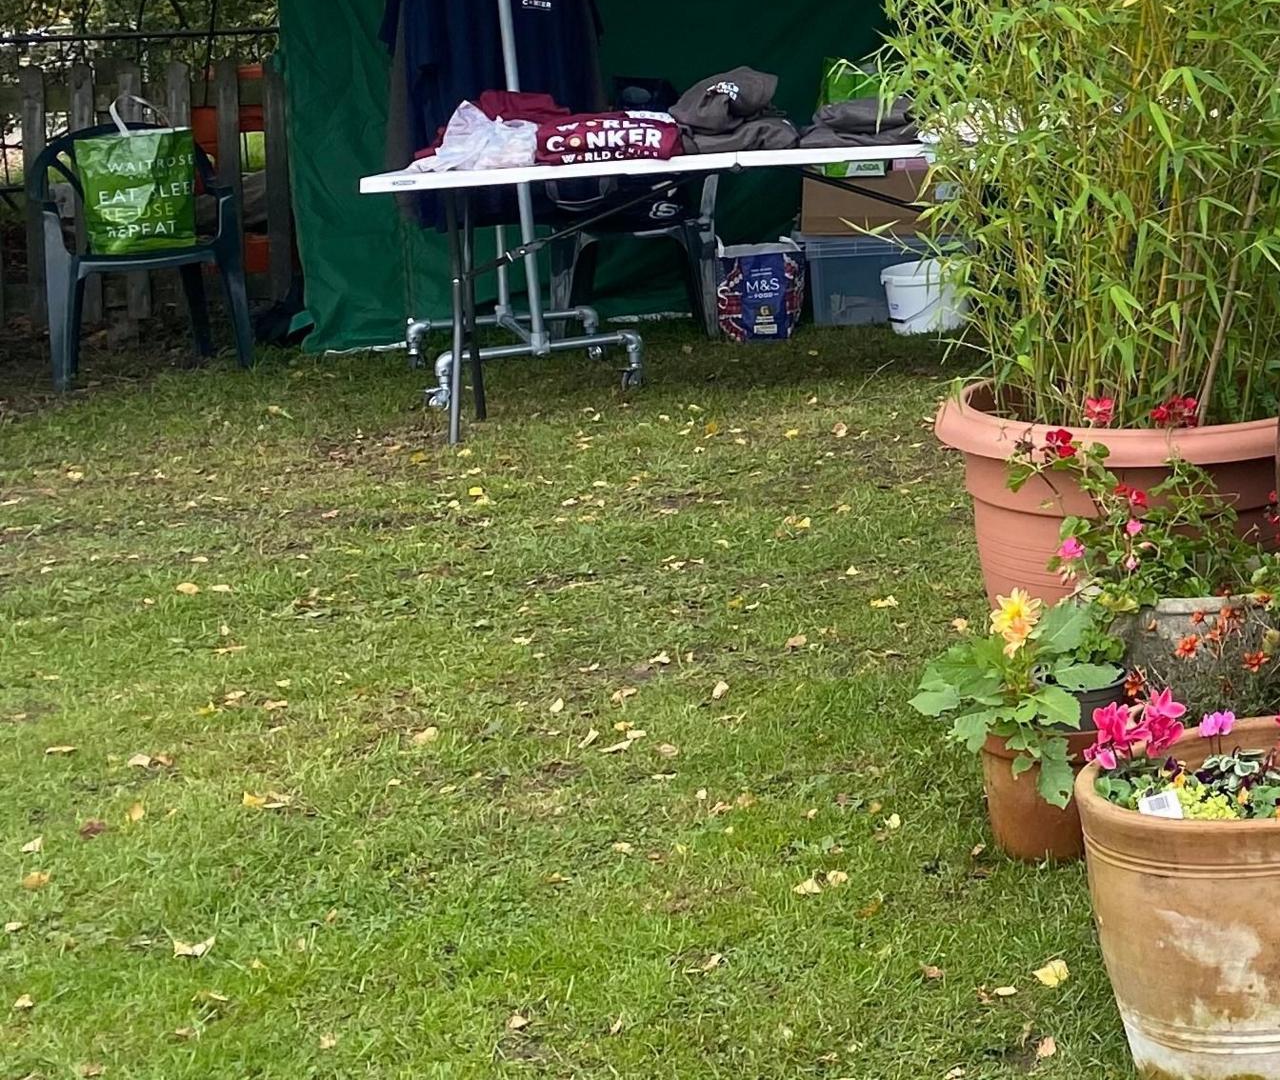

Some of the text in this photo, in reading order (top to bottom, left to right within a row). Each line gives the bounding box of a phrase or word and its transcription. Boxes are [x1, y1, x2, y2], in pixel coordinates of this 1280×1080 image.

[546, 128, 662, 152] CONKER
[856, 162, 880, 171] ASDA
[746, 277, 780, 293] M&S
